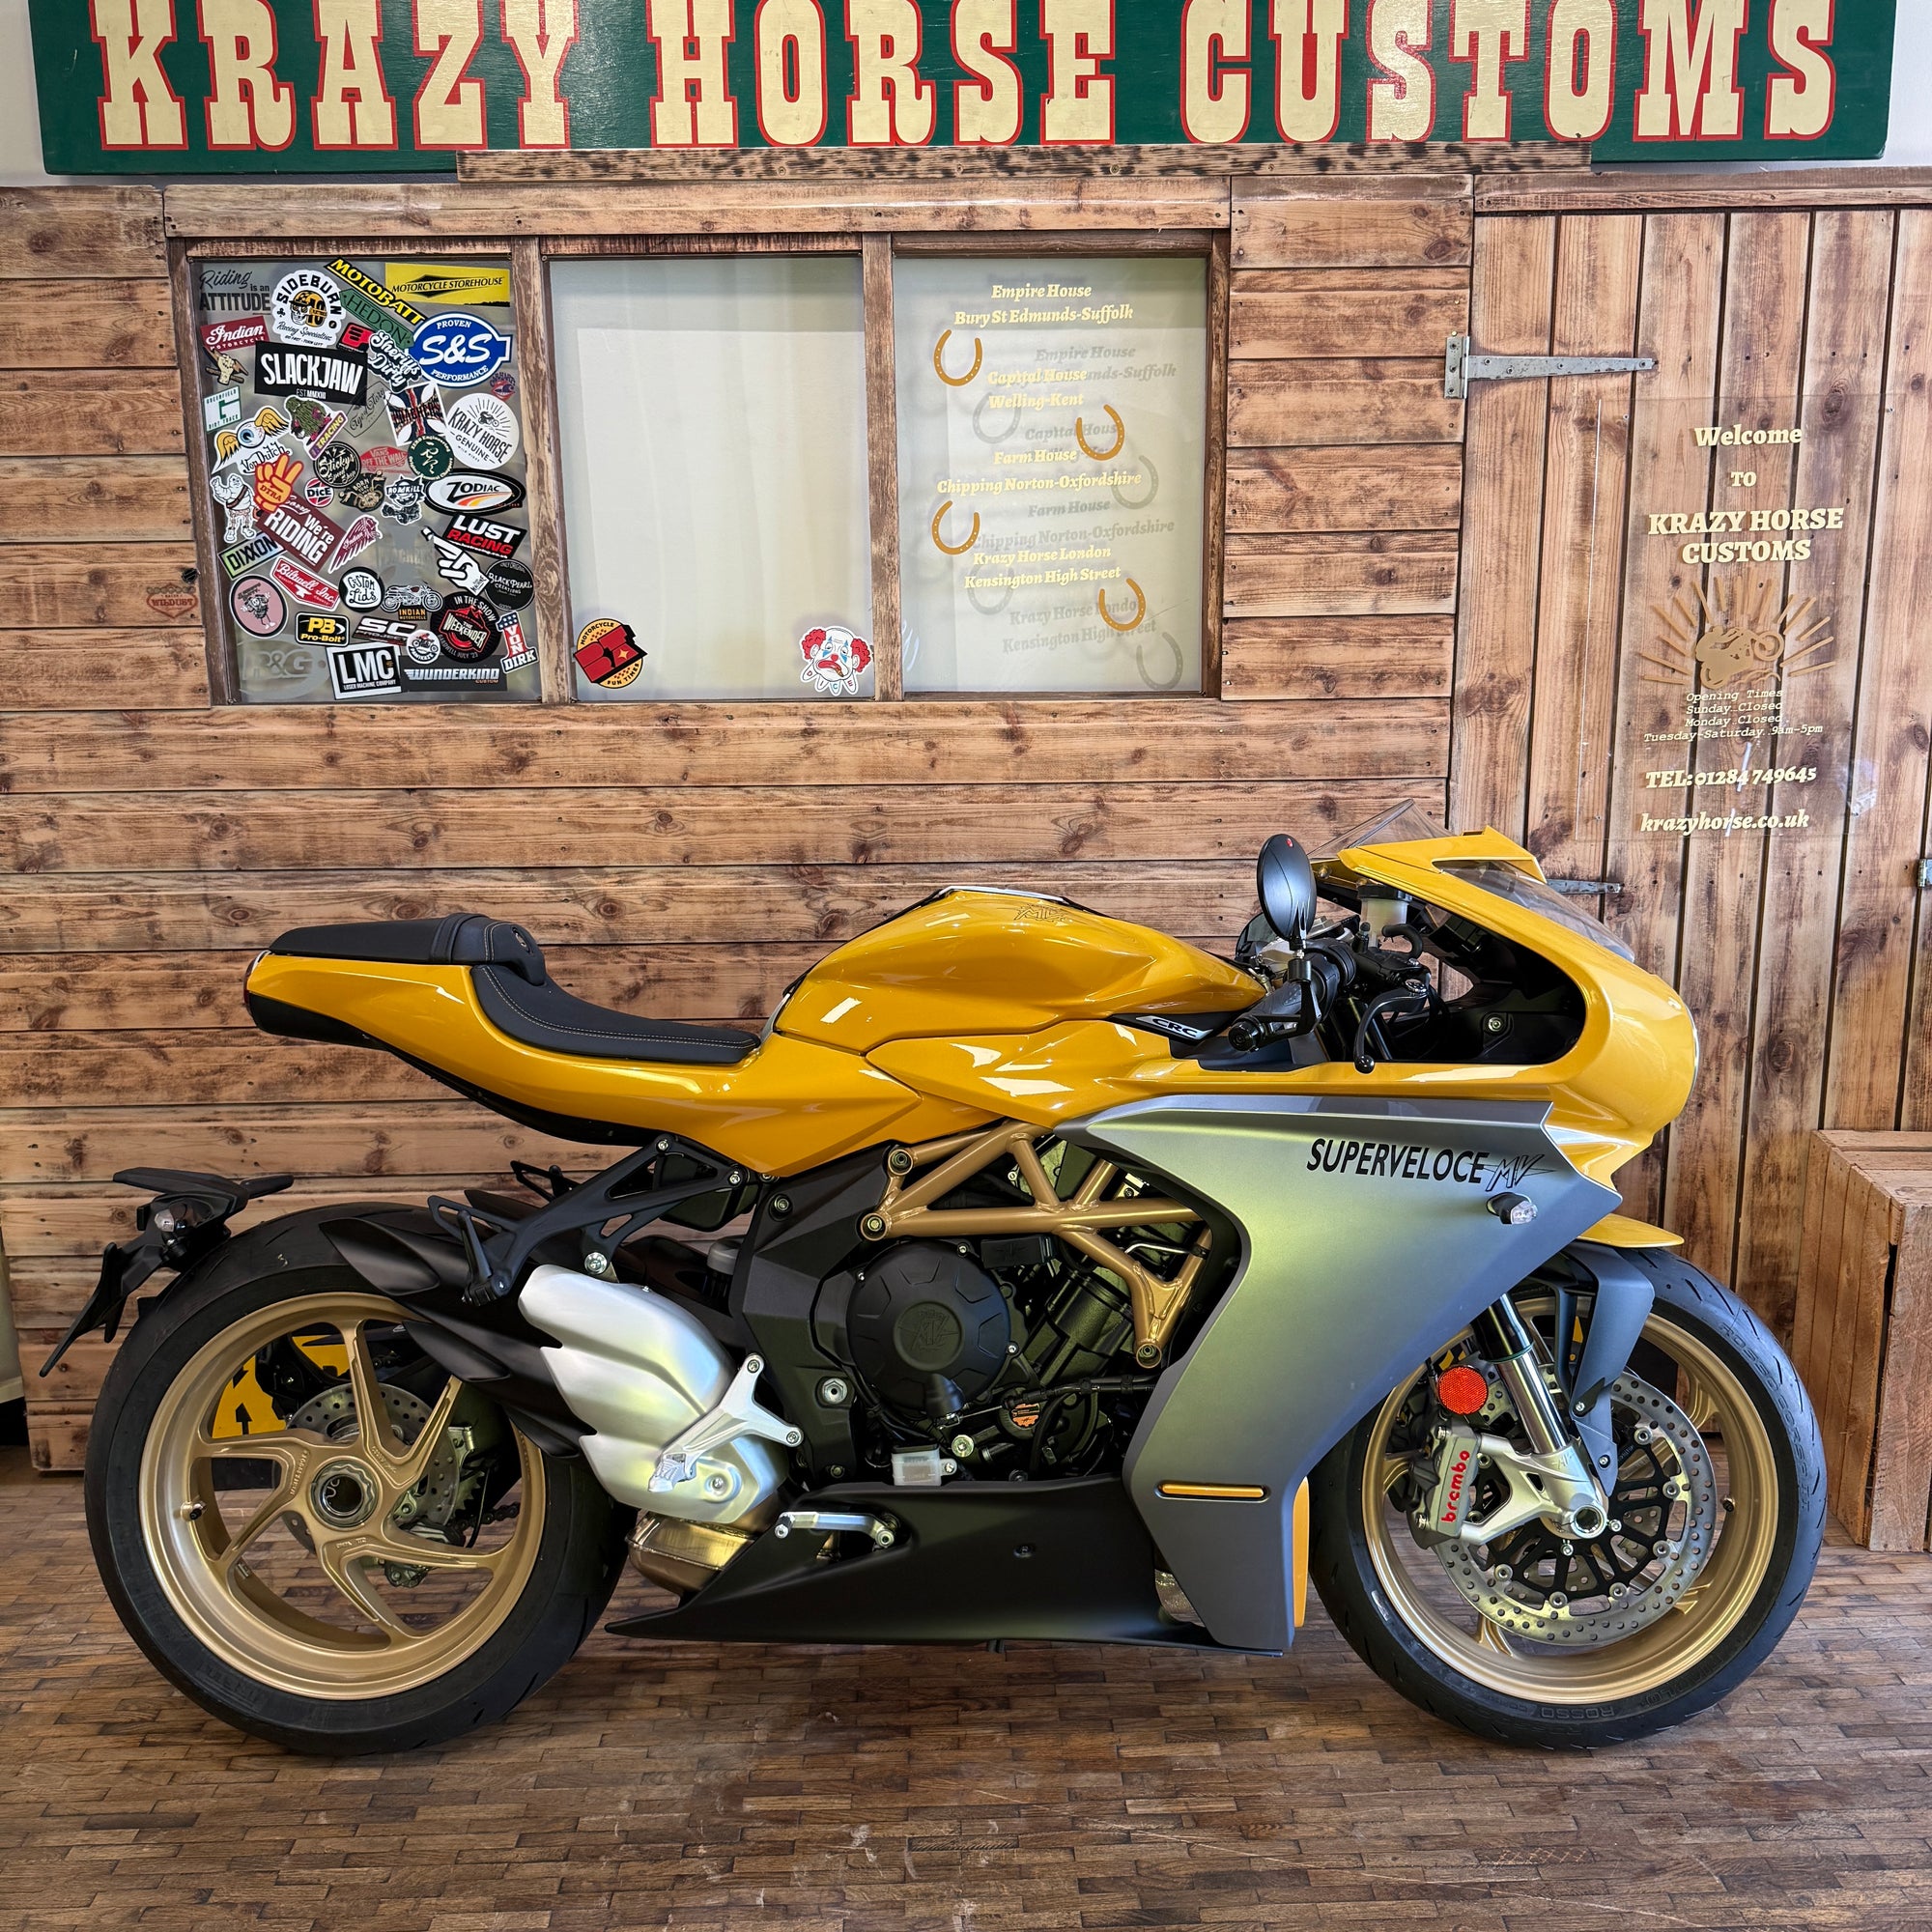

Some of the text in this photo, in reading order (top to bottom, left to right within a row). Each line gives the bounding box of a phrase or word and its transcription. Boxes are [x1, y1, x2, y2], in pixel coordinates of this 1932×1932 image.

[90, 0, 1835, 151] KRAZY HORSE CUSTOMS
[199, 269, 253, 290] Riding
[330, 258, 426, 325] MOTOBATT
[391, 276, 504, 294] MOTORCYCLE STOREHOUSE
[199, 293, 271, 311] ATTITUDE
[276, 273, 342, 316] SIDEBURN
[991, 283, 1093, 301] Empire House
[345, 295, 408, 345] HEDON
[436, 319, 472, 330] PROVEN
[953, 303, 1134, 328] Bury St Edmunds-Suffolk
[206, 325, 264, 346] Indian
[419, 333, 493, 366] S&S
[260, 353, 364, 395] SLACKJAW
[431, 364, 489, 382] PERFORMANCE
[987, 370, 1041, 388] Capital
[1041, 368, 1088, 383] House
[988, 393, 1085, 412] Welling-Kent
[447, 407, 483, 439] KRAZY
[478, 430, 513, 464] HORSE
[1693, 424, 1803, 447] Welcome
[256, 440, 288, 465] Dutch
[455, 434, 490, 462] GENUINE
[994, 448, 1078, 465] Farm House
[936, 471, 1142, 497] Chipping Norton-Oxfordshire
[1730, 470, 1757, 487] TO
[260, 484, 282, 502] DTRA
[446, 481, 501, 504] ZODIAC
[452, 514, 522, 544] LUST
[1648, 507, 1844, 535] KRAZY HORSE
[264, 507, 328, 564] RIDING
[446, 528, 514, 554] RACING
[226, 535, 279, 572] DIXXON
[973, 544, 1112, 567] Krazy Horse London
[1682, 539, 1812, 564] CUSTOMS
[964, 566, 1122, 589] Kensington High Street
[454, 595, 463, 605] IN
[464, 595, 479, 607] THE
[477, 601, 497, 622] SHOW
[307, 616, 336, 634] PB
[357, 617, 416, 638] SC
[442, 612, 488, 649] WEEKENDER
[580, 621, 615, 645] MOTORCYCLE
[505, 624, 526, 655] VON
[337, 649, 395, 684] LMC
[503, 648, 537, 672] DIRK
[623, 663, 639, 682] TIMES
[1686, 689, 1783, 704] Opening Times
[1752, 766, 1817, 784] 749645
[1640, 809, 1810, 836] krazyhorse.co.uk
[1151, 1017, 1199, 1038] CRC
[1306, 1138, 1491, 1184] SUPERVELOCE
[1440, 1449, 1471, 1523] brembo
